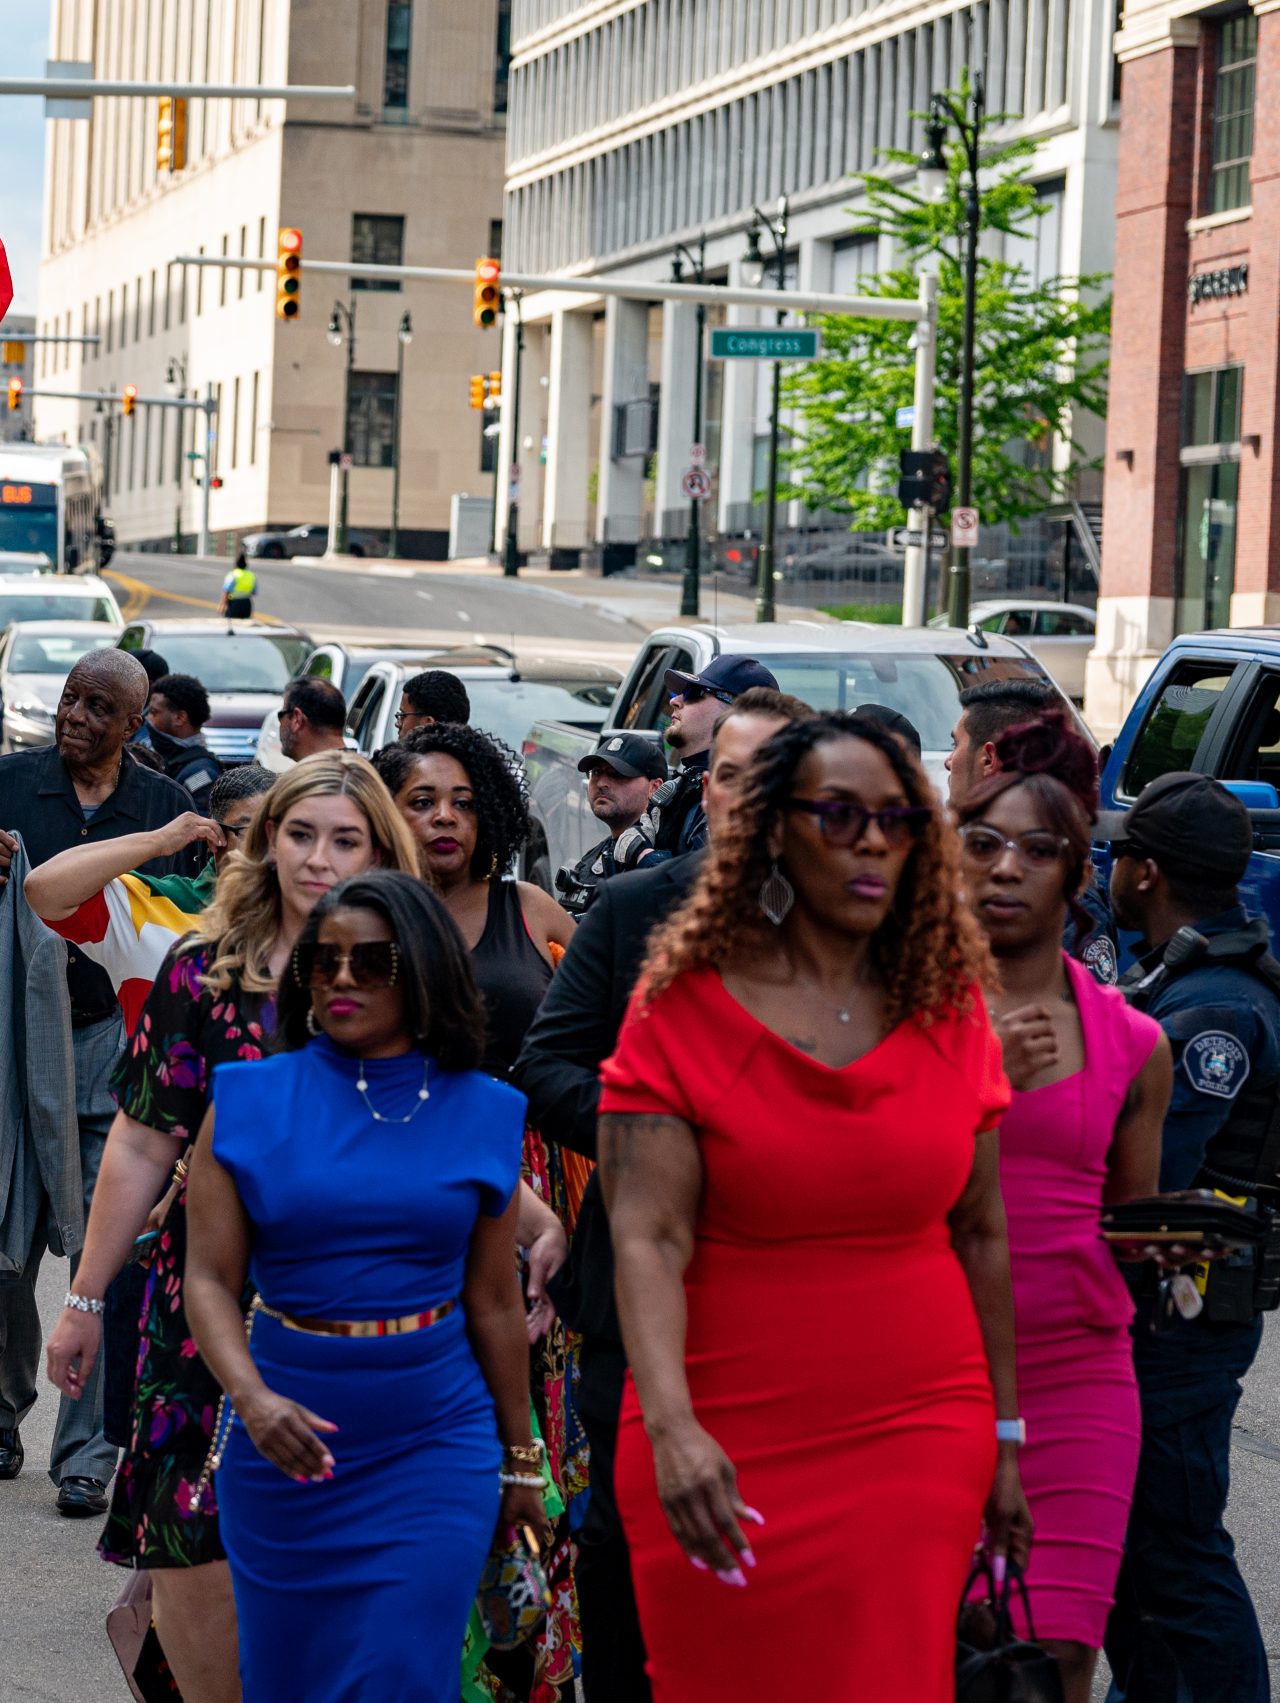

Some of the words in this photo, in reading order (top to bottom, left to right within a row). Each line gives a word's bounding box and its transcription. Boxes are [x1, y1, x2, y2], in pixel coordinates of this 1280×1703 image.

[726, 335, 801, 358] Congress
[2, 485, 32, 504] BUS
[1193, 1036, 1243, 1061] DETROIT
